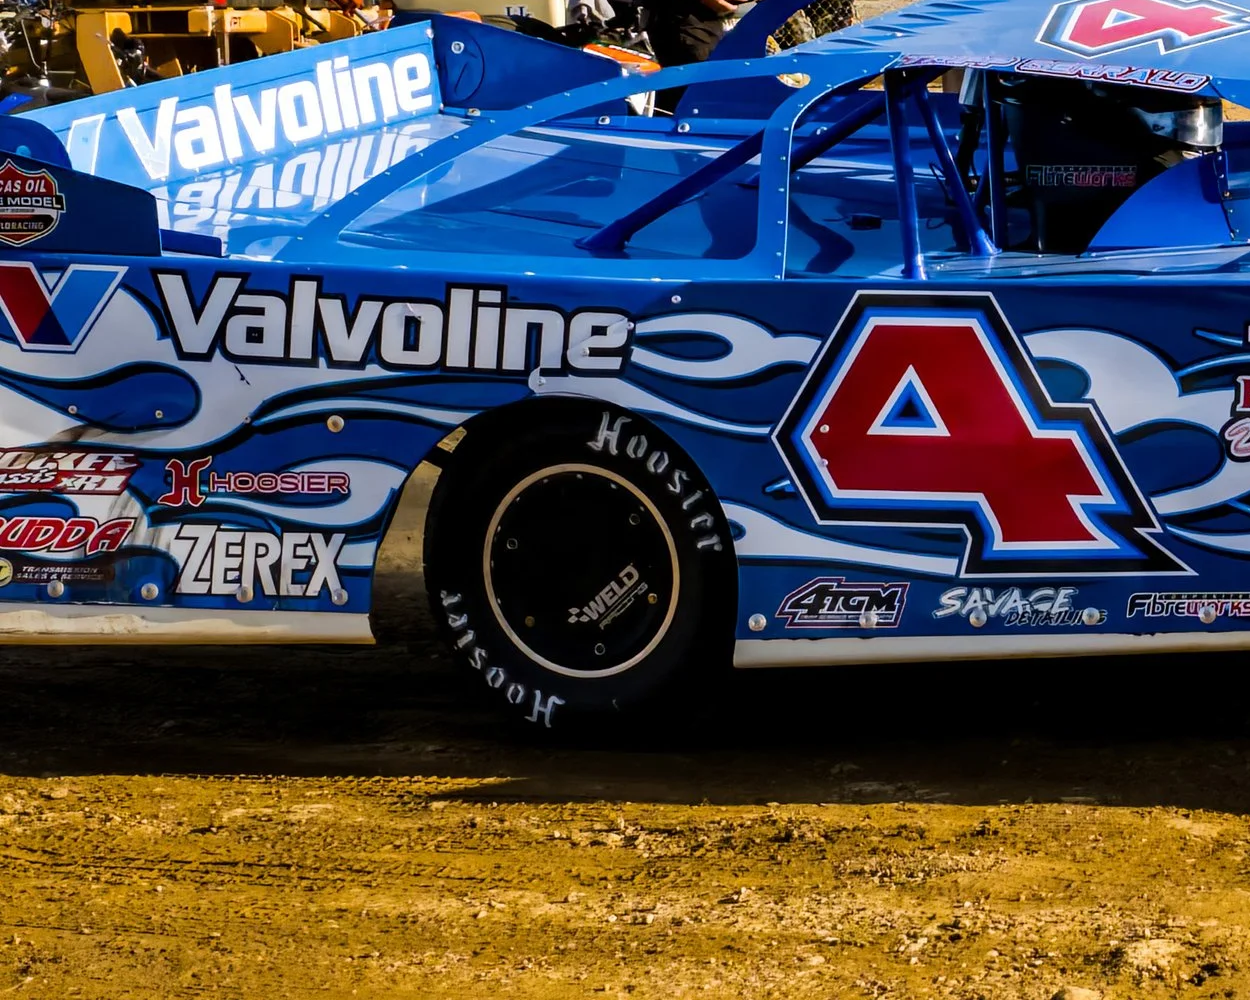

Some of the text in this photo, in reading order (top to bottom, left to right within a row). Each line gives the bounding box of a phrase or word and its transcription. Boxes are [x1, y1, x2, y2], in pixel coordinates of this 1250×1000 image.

[115, 52, 433, 180] Valvoline
[7, 197, 61, 208] MODEL
[25, 180, 47, 193] OIL
[154, 272, 631, 374] Valvoline
[788, 305, 1155, 562] 4
[209, 471, 351, 494] HOOSIER
[586, 411, 724, 552] Hoosier
[0, 516, 136, 556] UDDA
[174, 523, 347, 597] ZEREX
[582, 565, 639, 620] WELD
[932, 586, 1079, 620] SAVAGE
[1004, 609, 1108, 627] DETAILIG
